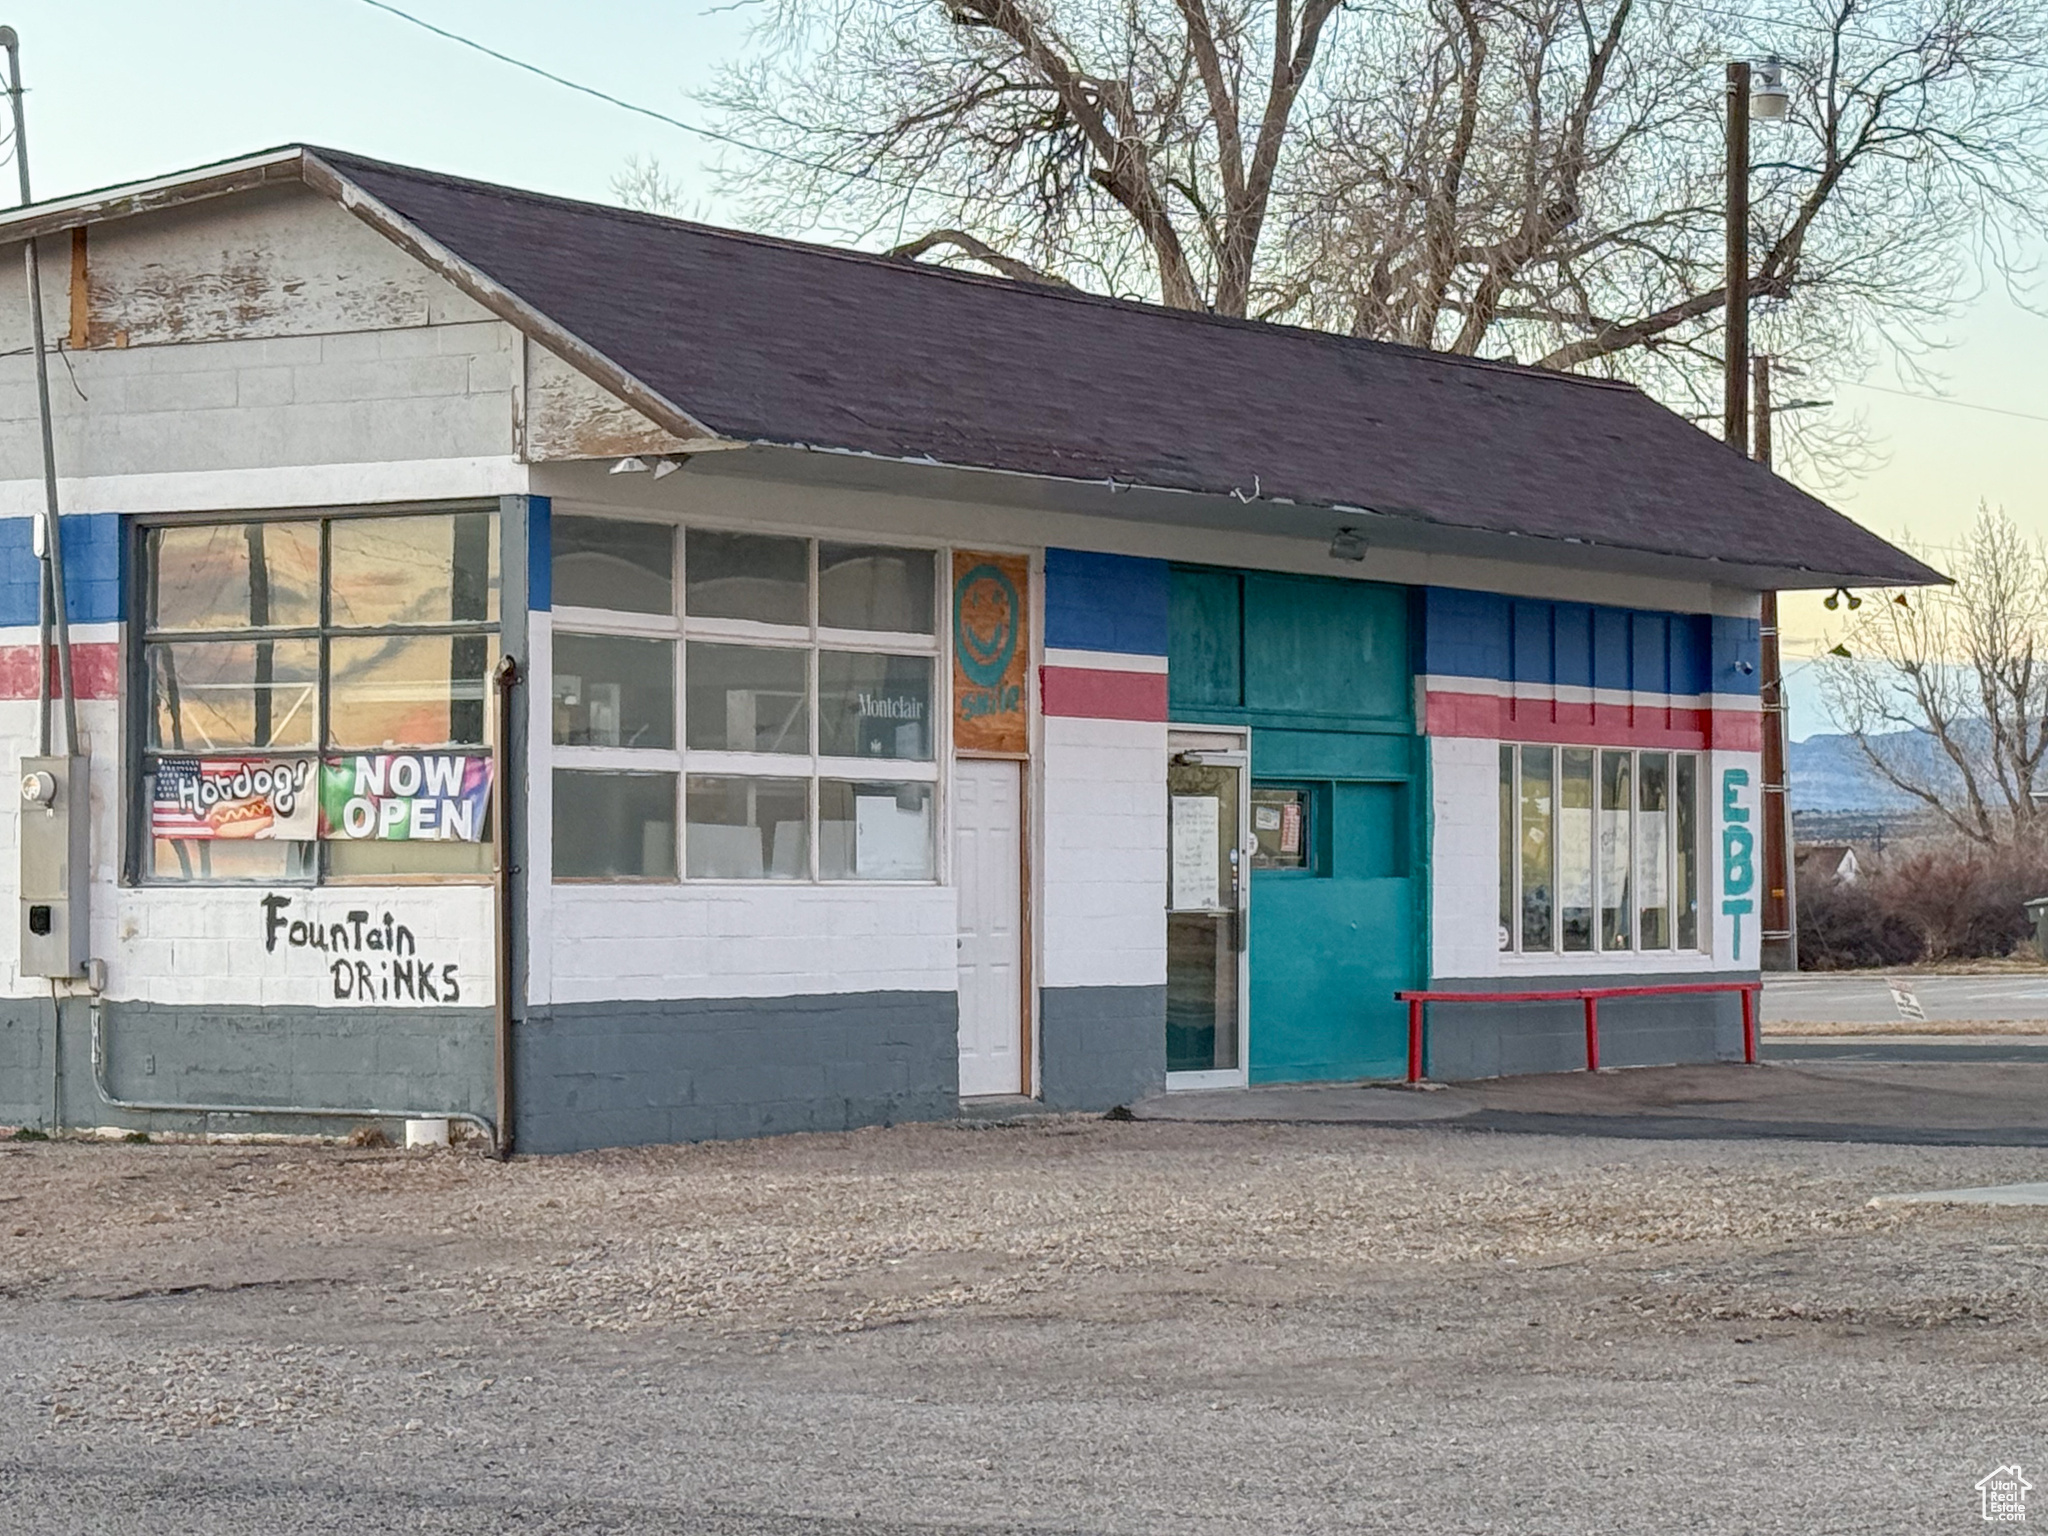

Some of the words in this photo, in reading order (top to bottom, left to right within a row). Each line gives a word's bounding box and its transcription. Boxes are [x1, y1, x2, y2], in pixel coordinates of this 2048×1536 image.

[858, 694, 923, 719] Montclair
[177, 760, 309, 818] Hotdogs
[353, 756, 467, 798] NOW
[342, 797, 473, 840] OPEN
[1721, 768, 1754, 962] EBT
